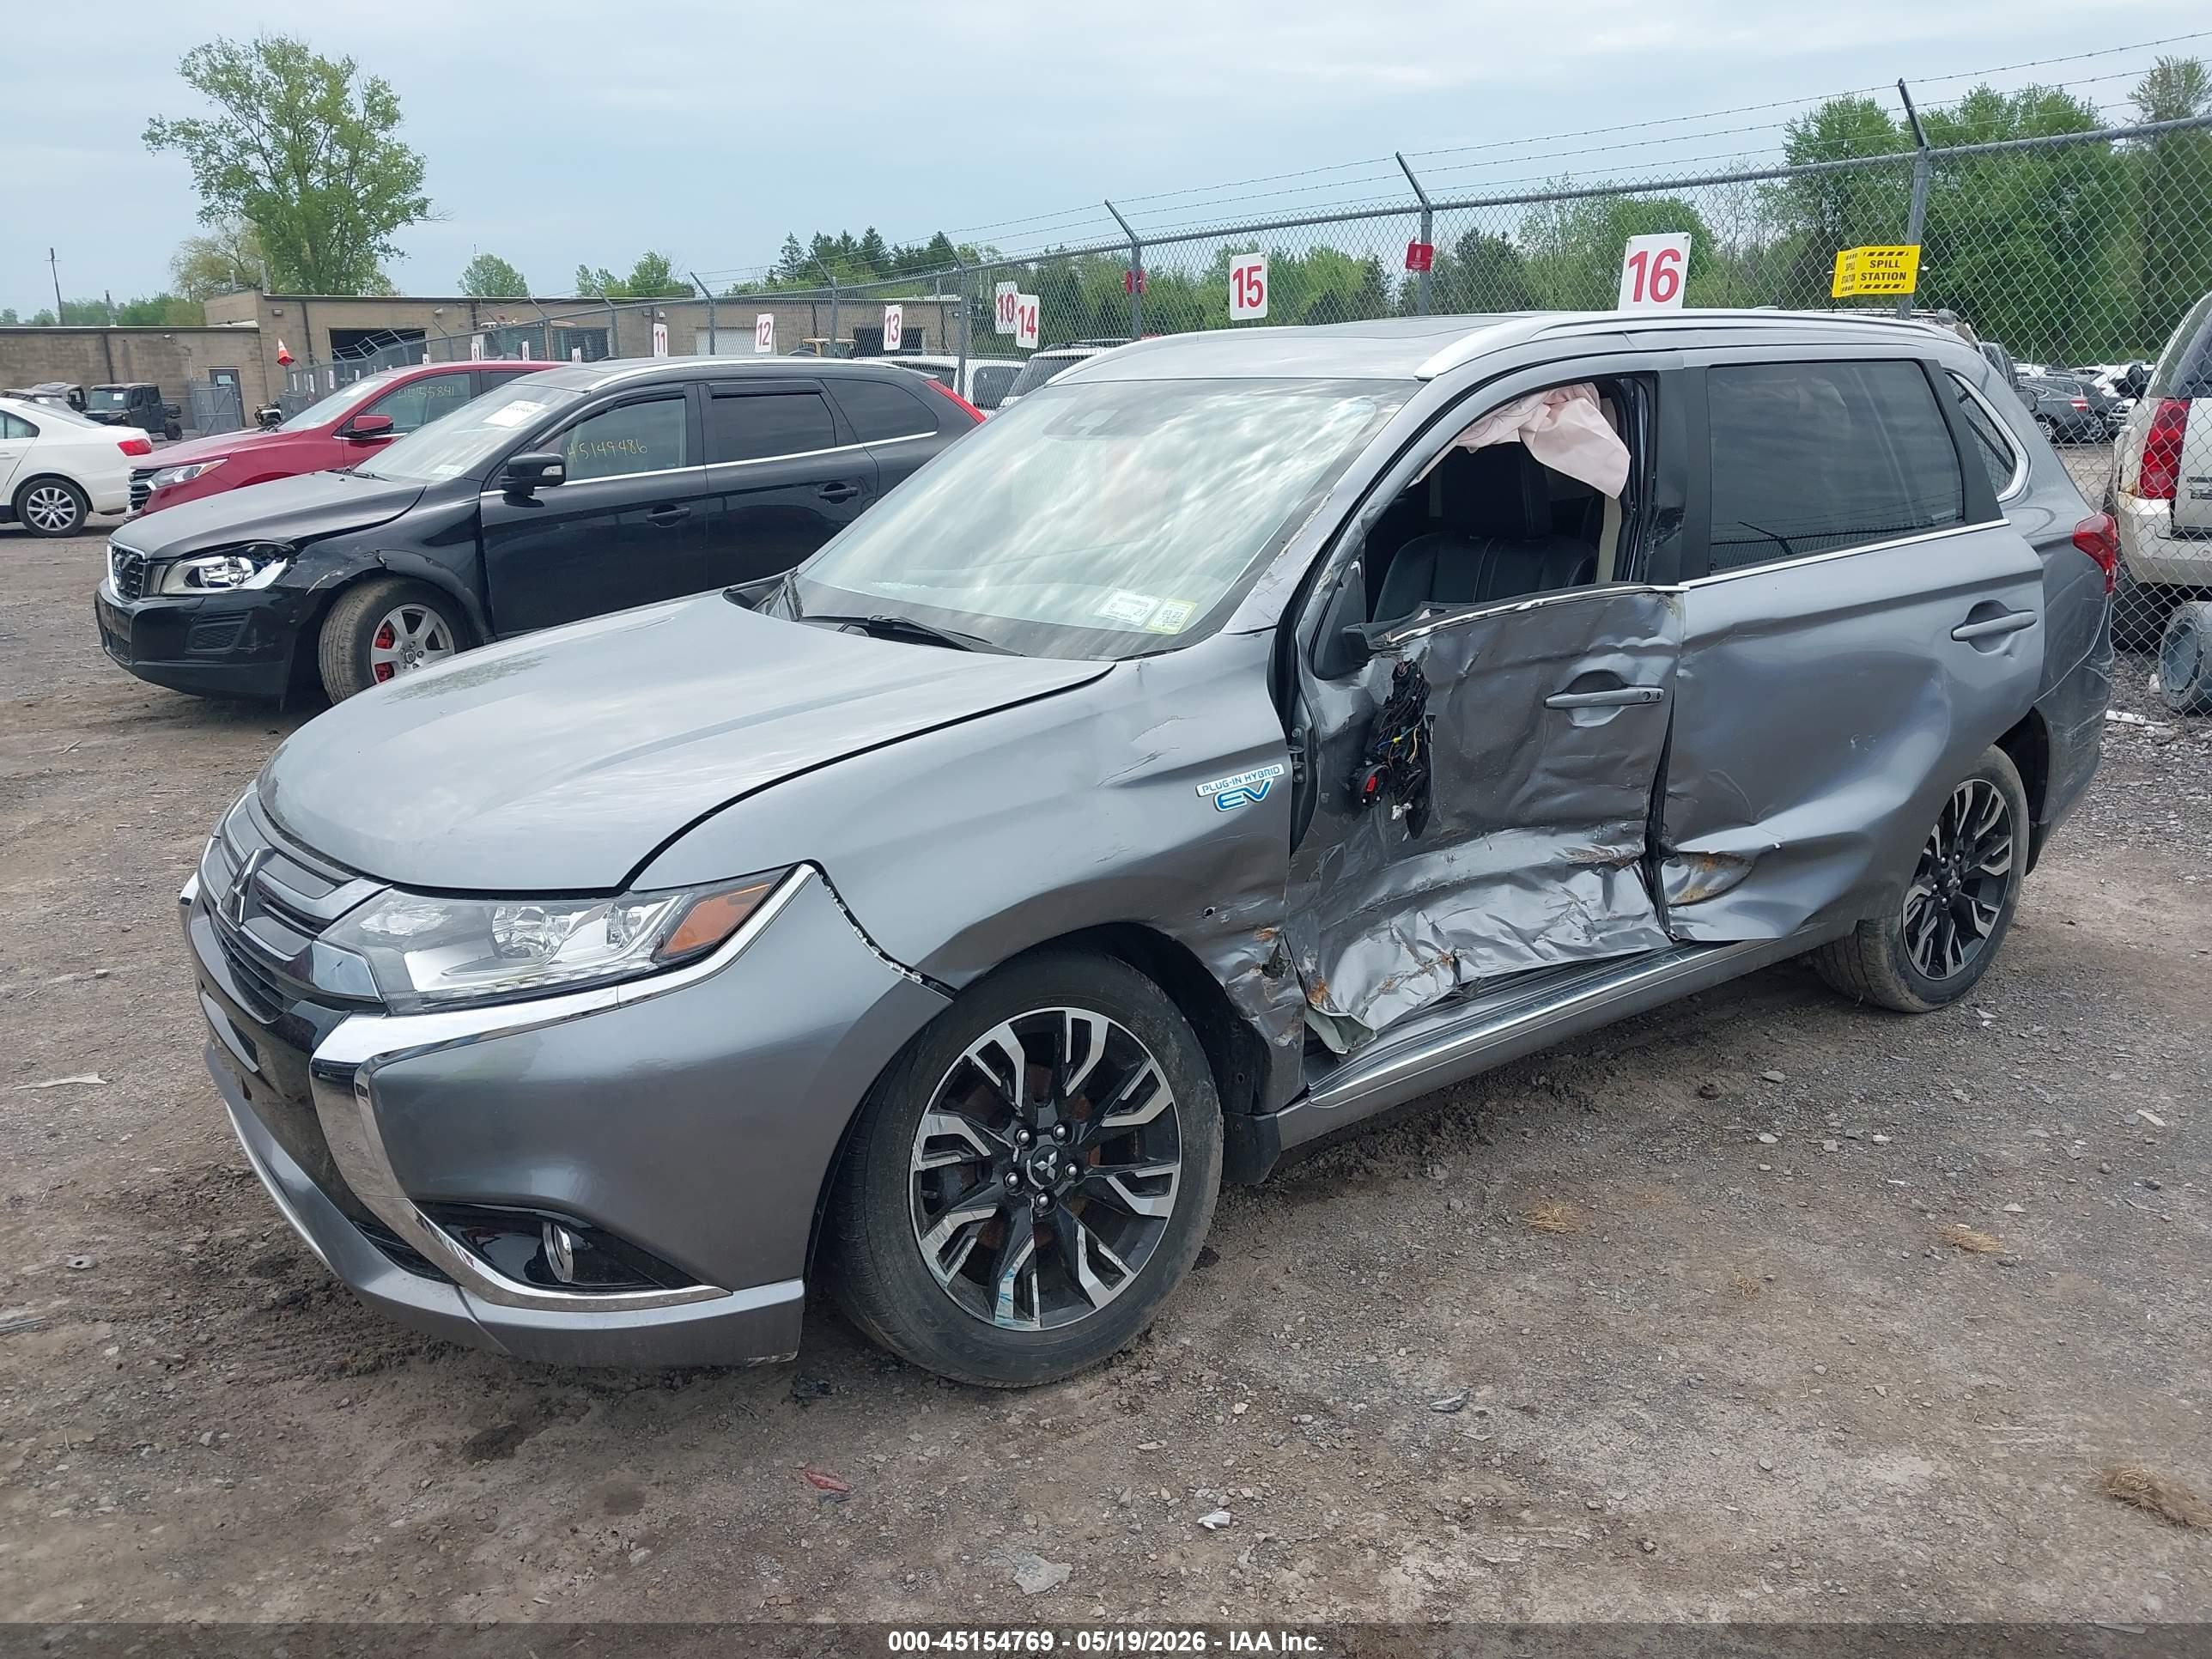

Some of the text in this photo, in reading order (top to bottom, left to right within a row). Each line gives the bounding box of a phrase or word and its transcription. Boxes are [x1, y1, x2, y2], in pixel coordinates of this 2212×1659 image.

[1628, 248, 1681, 303] 16
[1860, 271, 1906, 281] STATION
[1869, 259, 1900, 269] SPILL
[1231, 264, 1264, 309] 15
[998, 293, 1016, 325] 10
[1018, 305, 1036, 339] 14
[654, 330, 665, 353] 11
[757, 321, 771, 347] 12
[886, 313, 900, 343] 13
[567, 438, 648, 463] 45149486
[1201, 766, 1280, 794] PLUG-IN HYBRID
[1216, 779, 1273, 811] EV
